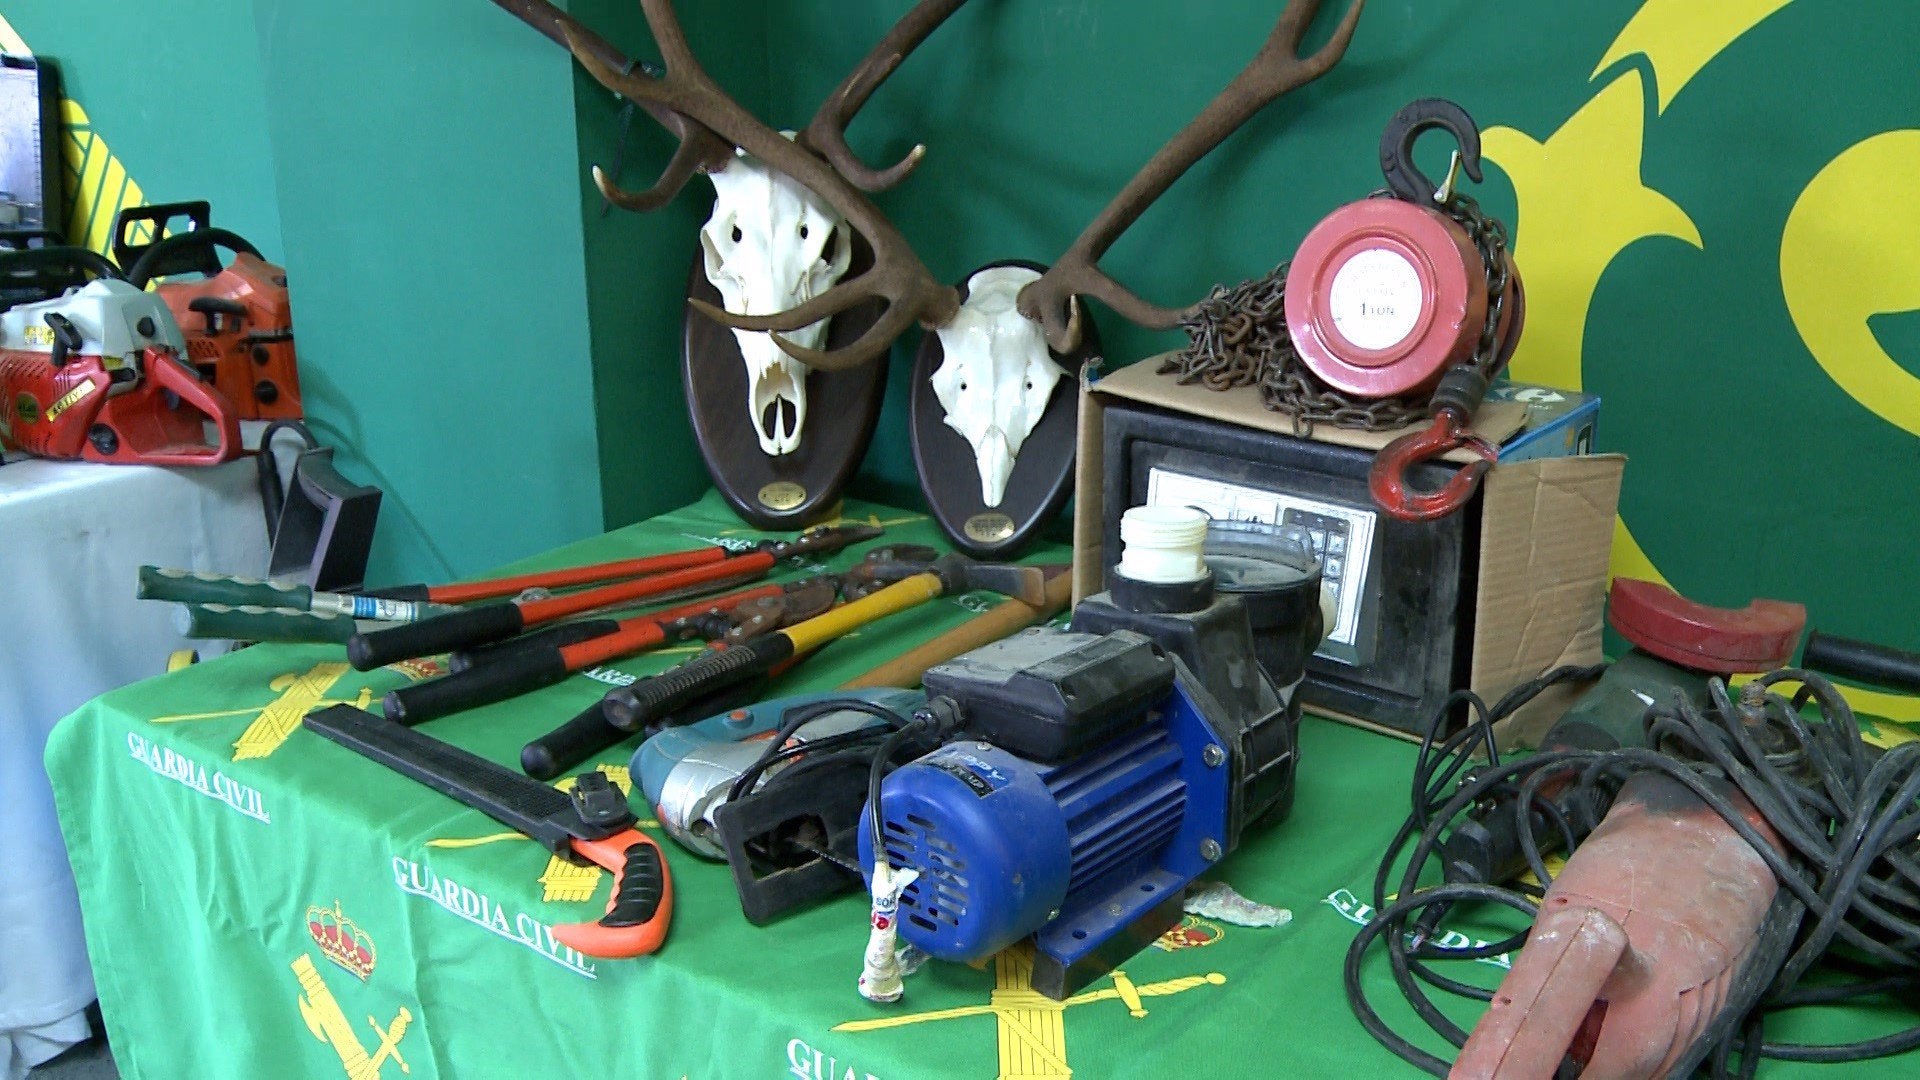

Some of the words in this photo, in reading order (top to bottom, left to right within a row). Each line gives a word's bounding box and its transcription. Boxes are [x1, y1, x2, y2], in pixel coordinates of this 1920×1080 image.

[127, 731, 209, 792] GUARDIA
[212, 771, 271, 822] CIVIL
[392, 856, 511, 932] GUARDIA
